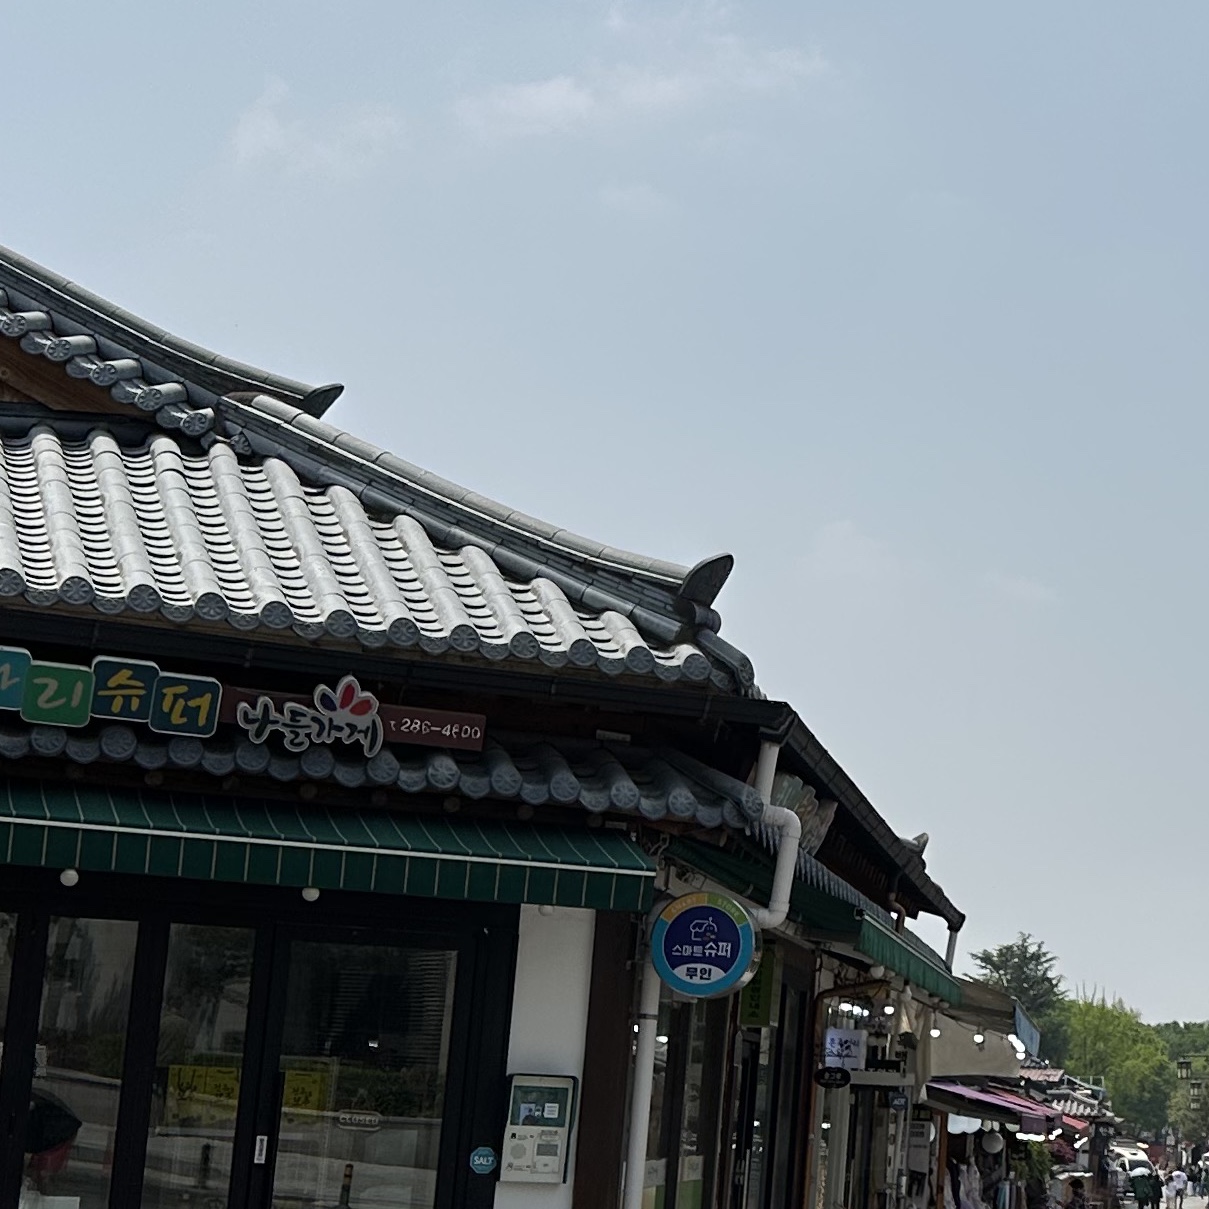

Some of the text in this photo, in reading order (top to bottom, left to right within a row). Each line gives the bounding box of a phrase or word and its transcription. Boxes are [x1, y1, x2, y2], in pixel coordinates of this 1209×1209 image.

[240, 697, 381, 757] 나들가게
[672, 941, 732, 958] 스마트슈퍼
[685, 966, 712, 981] 무인
